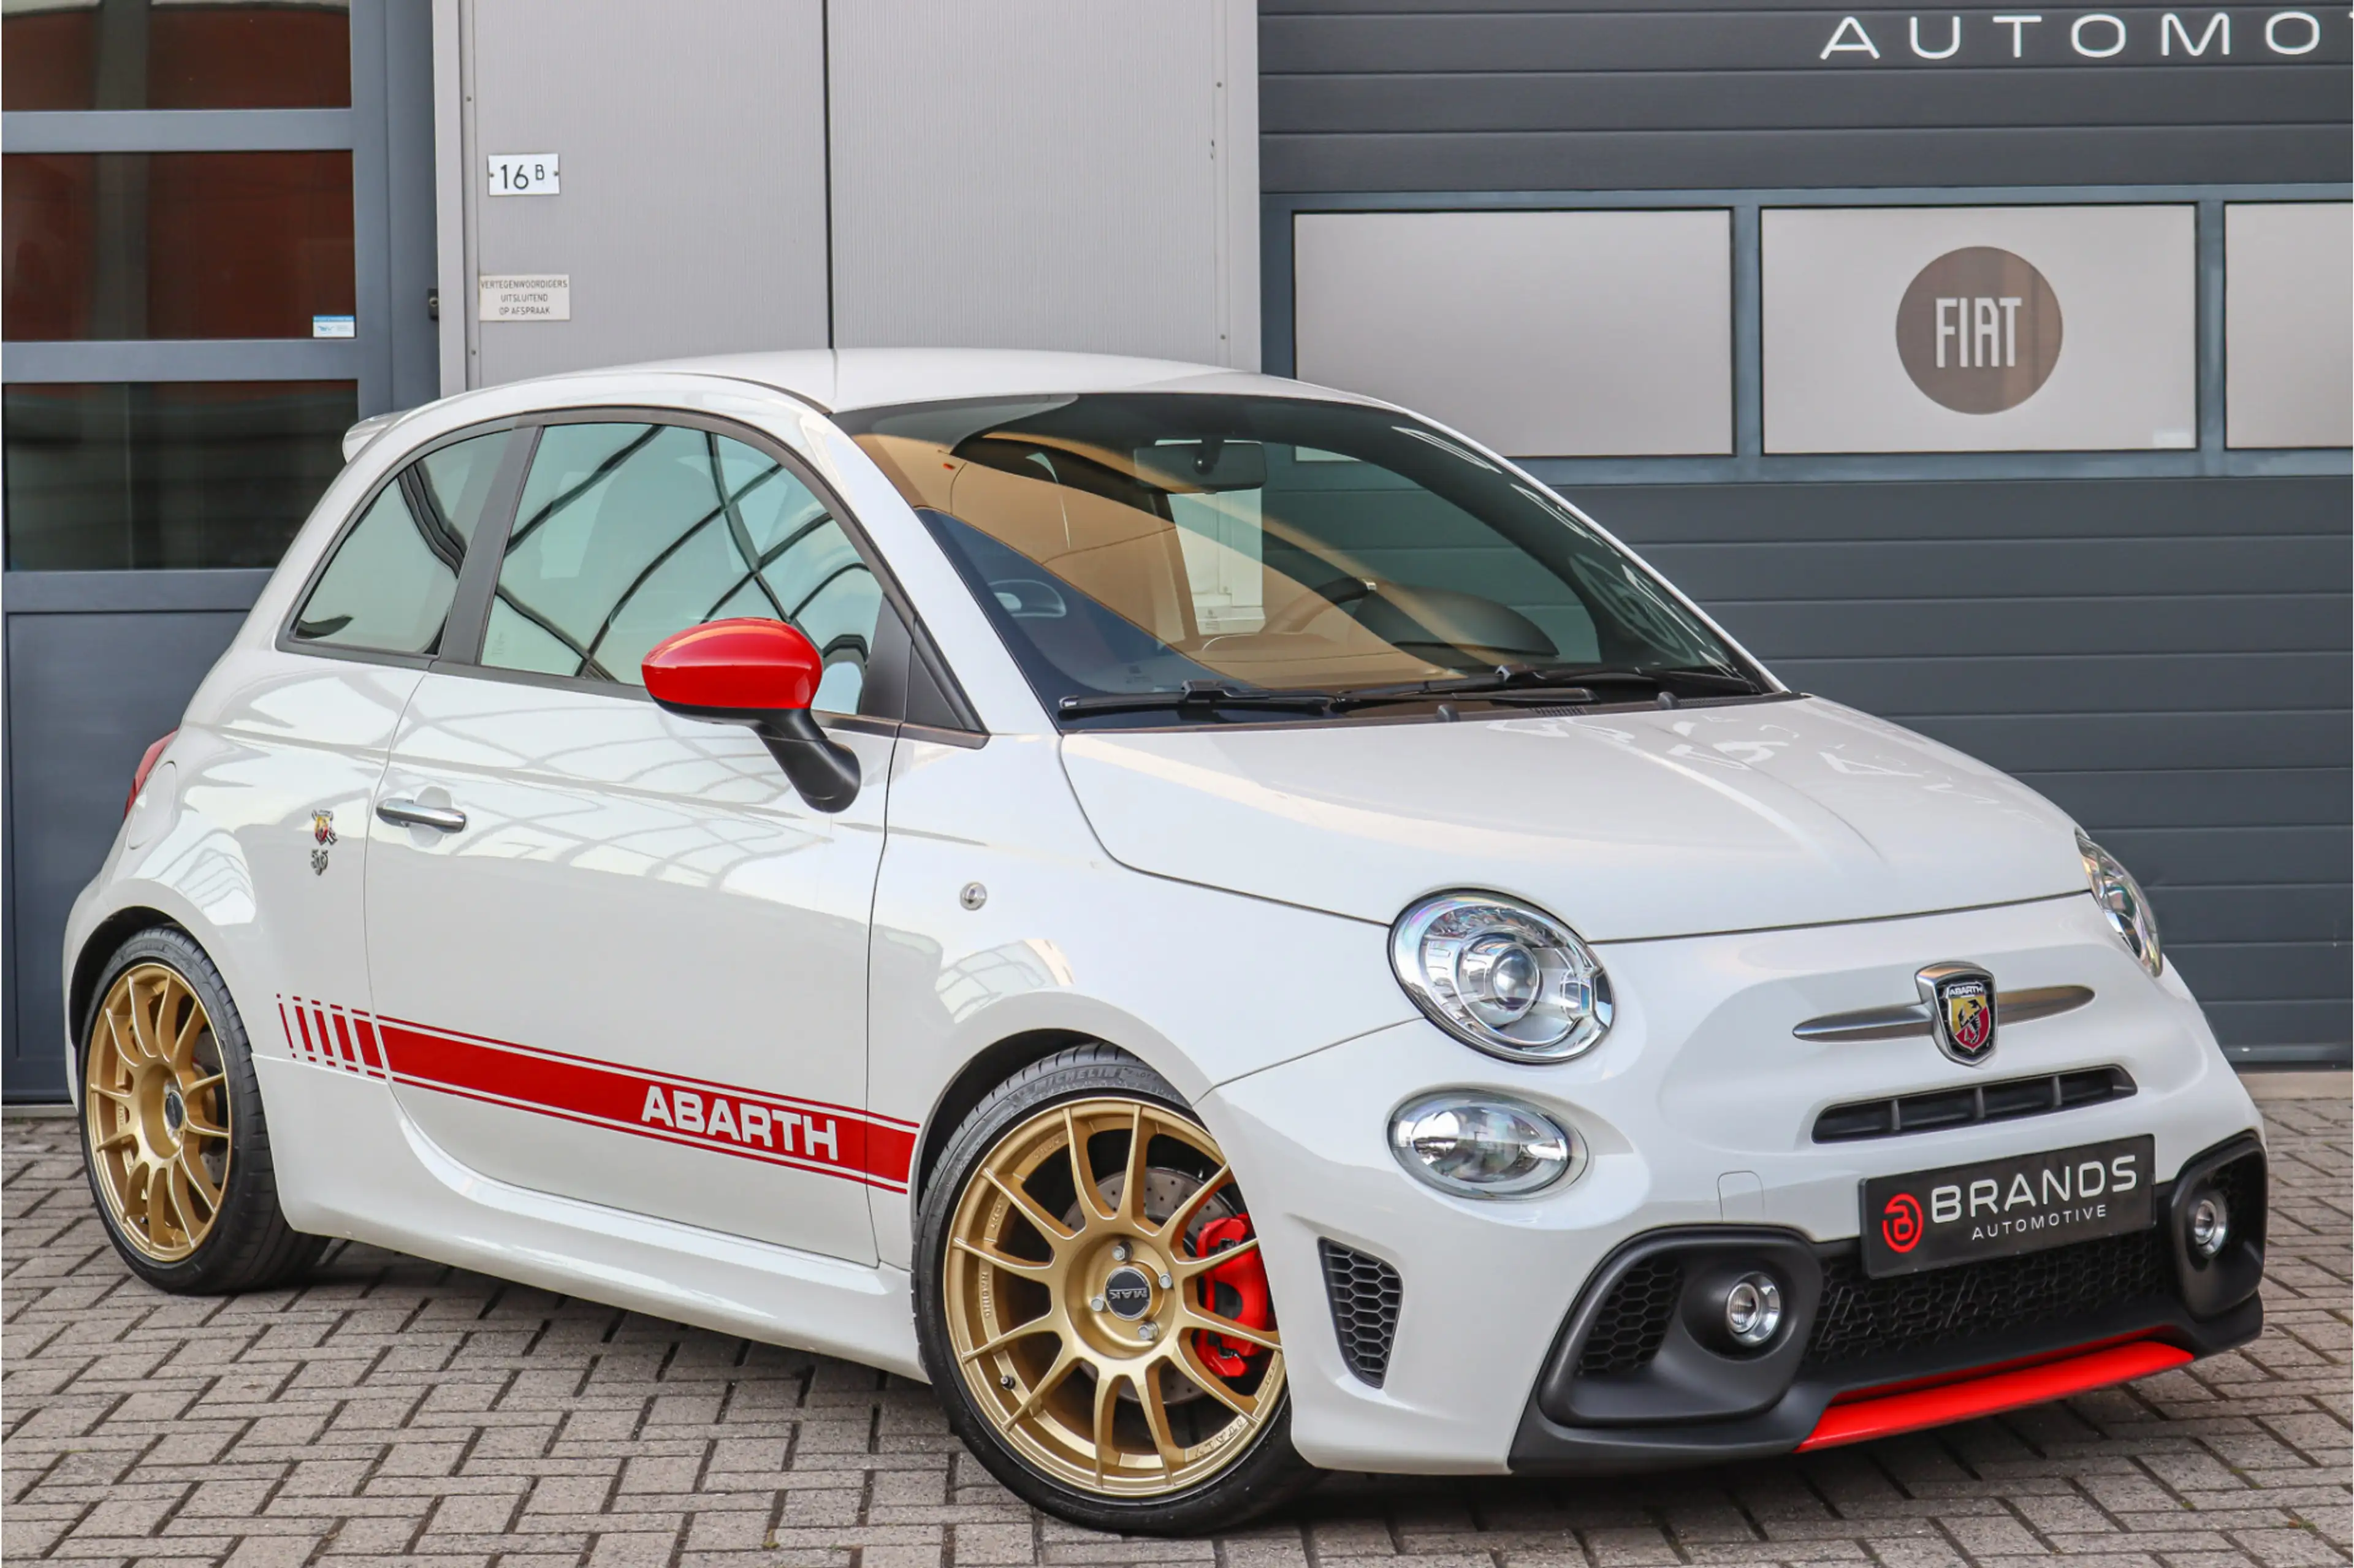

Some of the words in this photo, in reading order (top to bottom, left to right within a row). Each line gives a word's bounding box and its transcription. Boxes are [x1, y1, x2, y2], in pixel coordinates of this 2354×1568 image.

[1819, 11, 2353, 60] AUTOMO
[481, 280, 568, 289] VERTEGENWOORDIGERS
[500, 294, 548, 303] UITSLUITEND
[498, 306, 510, 316] OP
[511, 306, 550, 315] AFSPRAAK
[1935, 297, 2022, 368] FIAT
[1948, 986, 1983, 996] ABARTH
[641, 1085, 838, 1161] ABARTH
[1931, 1155, 2137, 1224] BRANDS
[1971, 1204, 2107, 1241] AUTOMOTIVE
[1109, 1288, 1148, 1299] MAK
